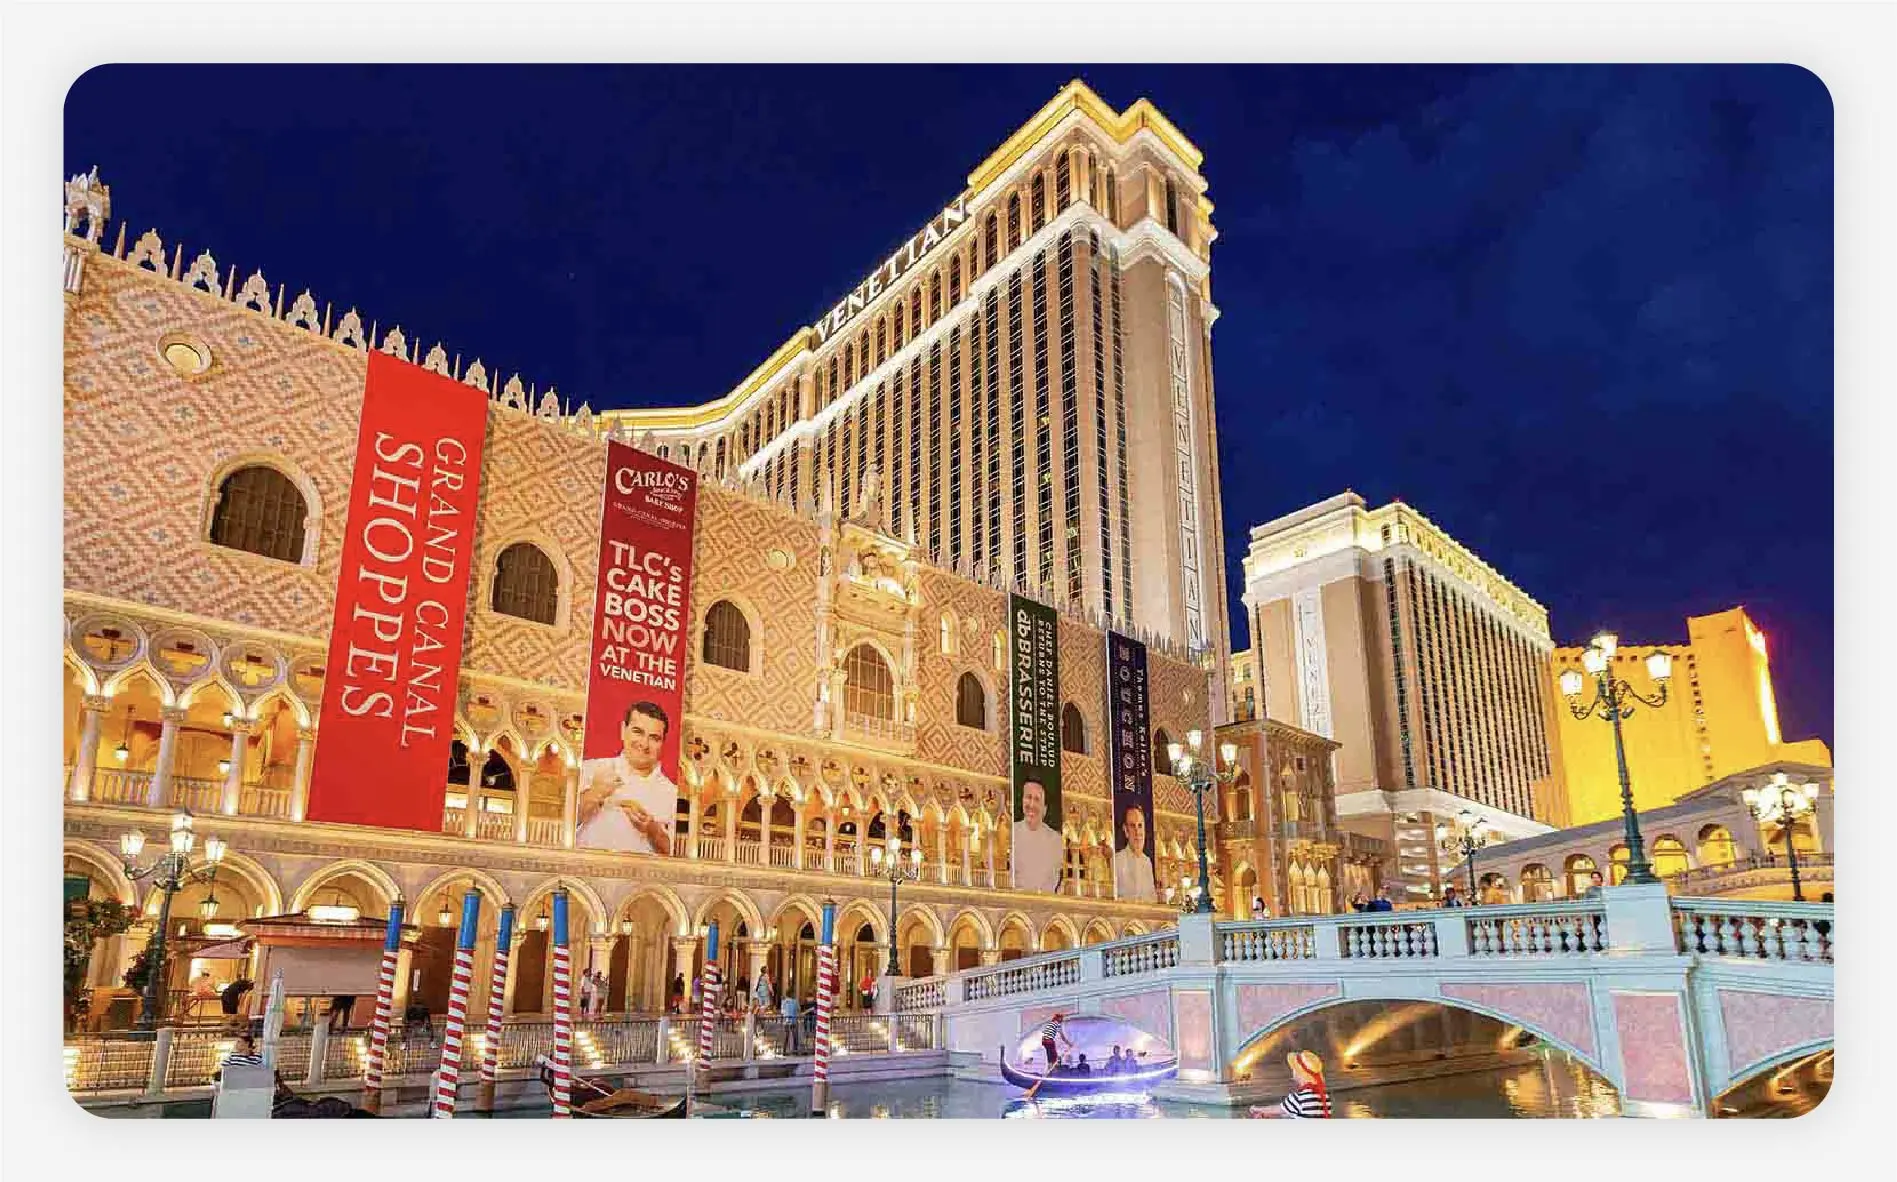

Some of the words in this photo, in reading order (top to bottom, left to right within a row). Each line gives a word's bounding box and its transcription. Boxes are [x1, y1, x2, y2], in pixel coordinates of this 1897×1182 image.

[815, 194, 967, 343] VENETIAN
[614, 467, 690, 495] CARLO'S
[421, 436, 467, 585] GRAND
[341, 430, 425, 721] SHOPPES
[608, 539, 683, 583] TLC's
[606, 567, 682, 607] CAKE
[604, 590, 681, 632] BOSS
[601, 616, 678, 657] NOW
[400, 599, 449, 748] CANAL
[599, 662, 677, 691] VENETIAN
[600, 644, 631, 665] AT
[636, 650, 677, 678] THE
[1039, 679, 1047, 696] TO
[1046, 660, 1054, 709] DANIEL
[1039, 701, 1047, 726] THE
[1047, 713, 1056, 768] BOULUD
